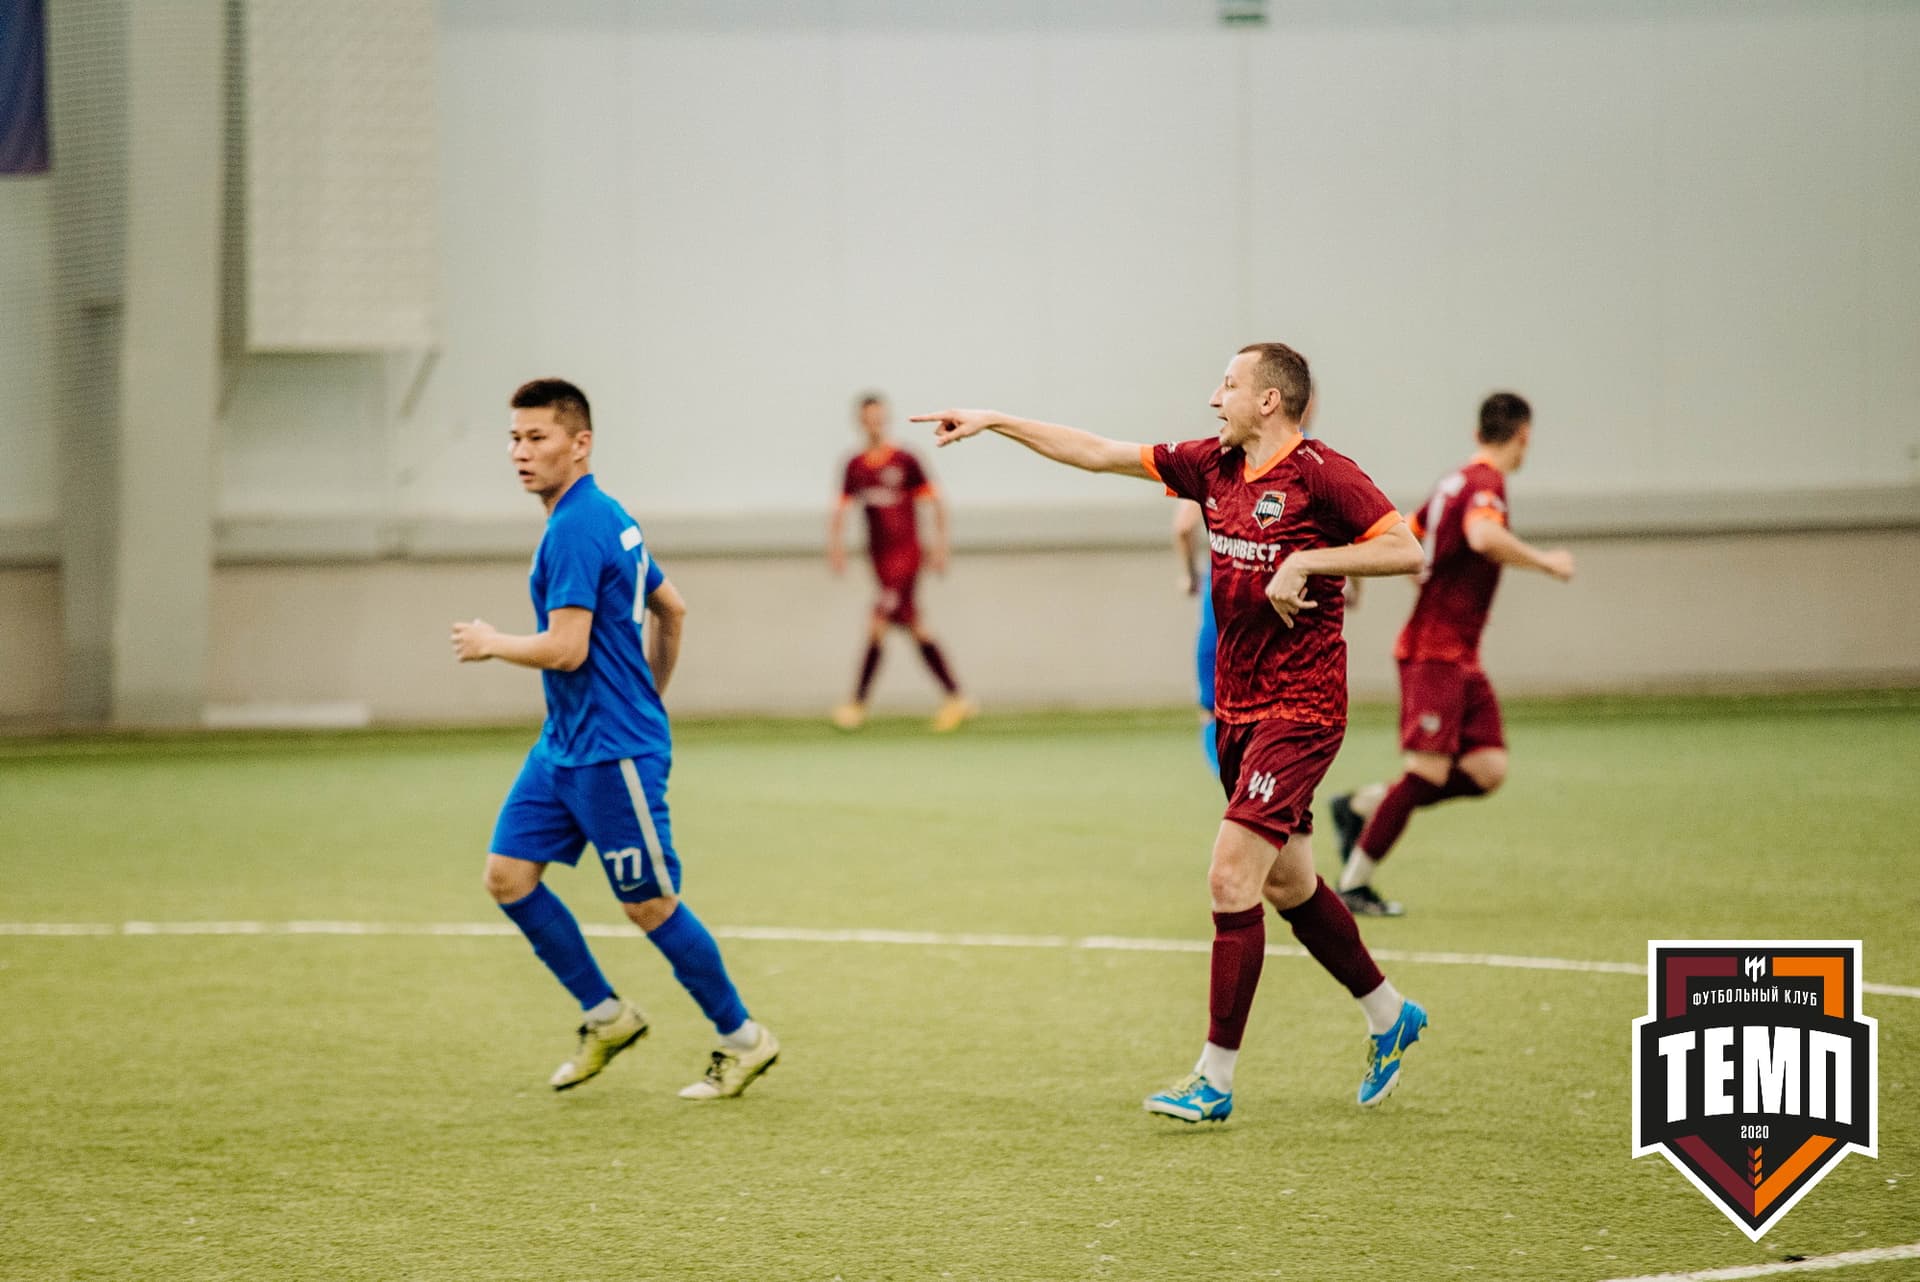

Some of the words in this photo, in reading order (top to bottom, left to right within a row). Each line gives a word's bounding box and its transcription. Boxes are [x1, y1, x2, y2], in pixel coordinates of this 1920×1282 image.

[1257, 498, 1282, 517] ТЕМП
[1247, 769, 1277, 804] 44
[603, 846, 642, 881] 77
